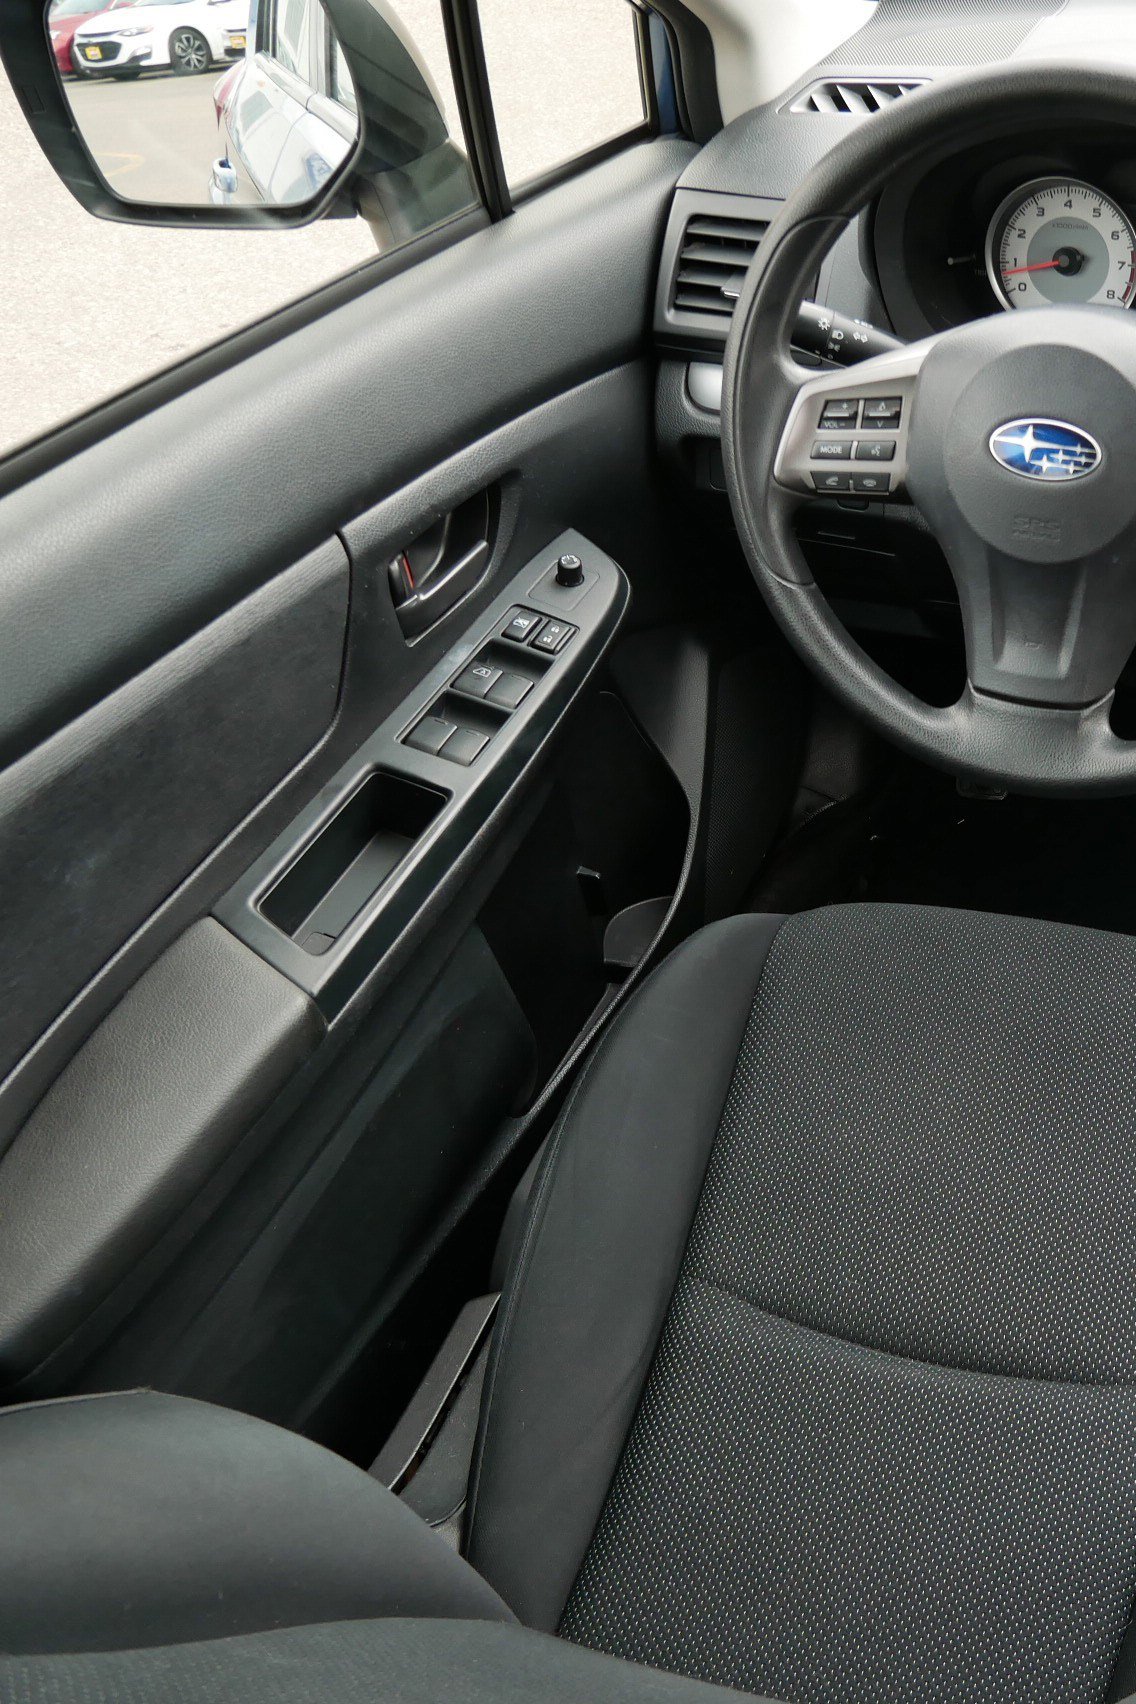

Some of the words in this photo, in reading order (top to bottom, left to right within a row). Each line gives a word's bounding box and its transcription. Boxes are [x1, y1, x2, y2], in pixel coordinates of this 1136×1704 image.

[1064, 200, 1072, 209] 4
[1036, 207, 1045, 217] 3
[1092, 208, 1101, 218] 5
[1017, 229, 1026, 239] 2
[1111, 231, 1120, 240] 6
[1013, 258, 1018, 267] 1
[1117, 261, 1126, 270] 7
[1018, 282, 1027, 292] 0
[1106, 290, 1115, 299] 8
[820, 445, 843, 454] MODE
